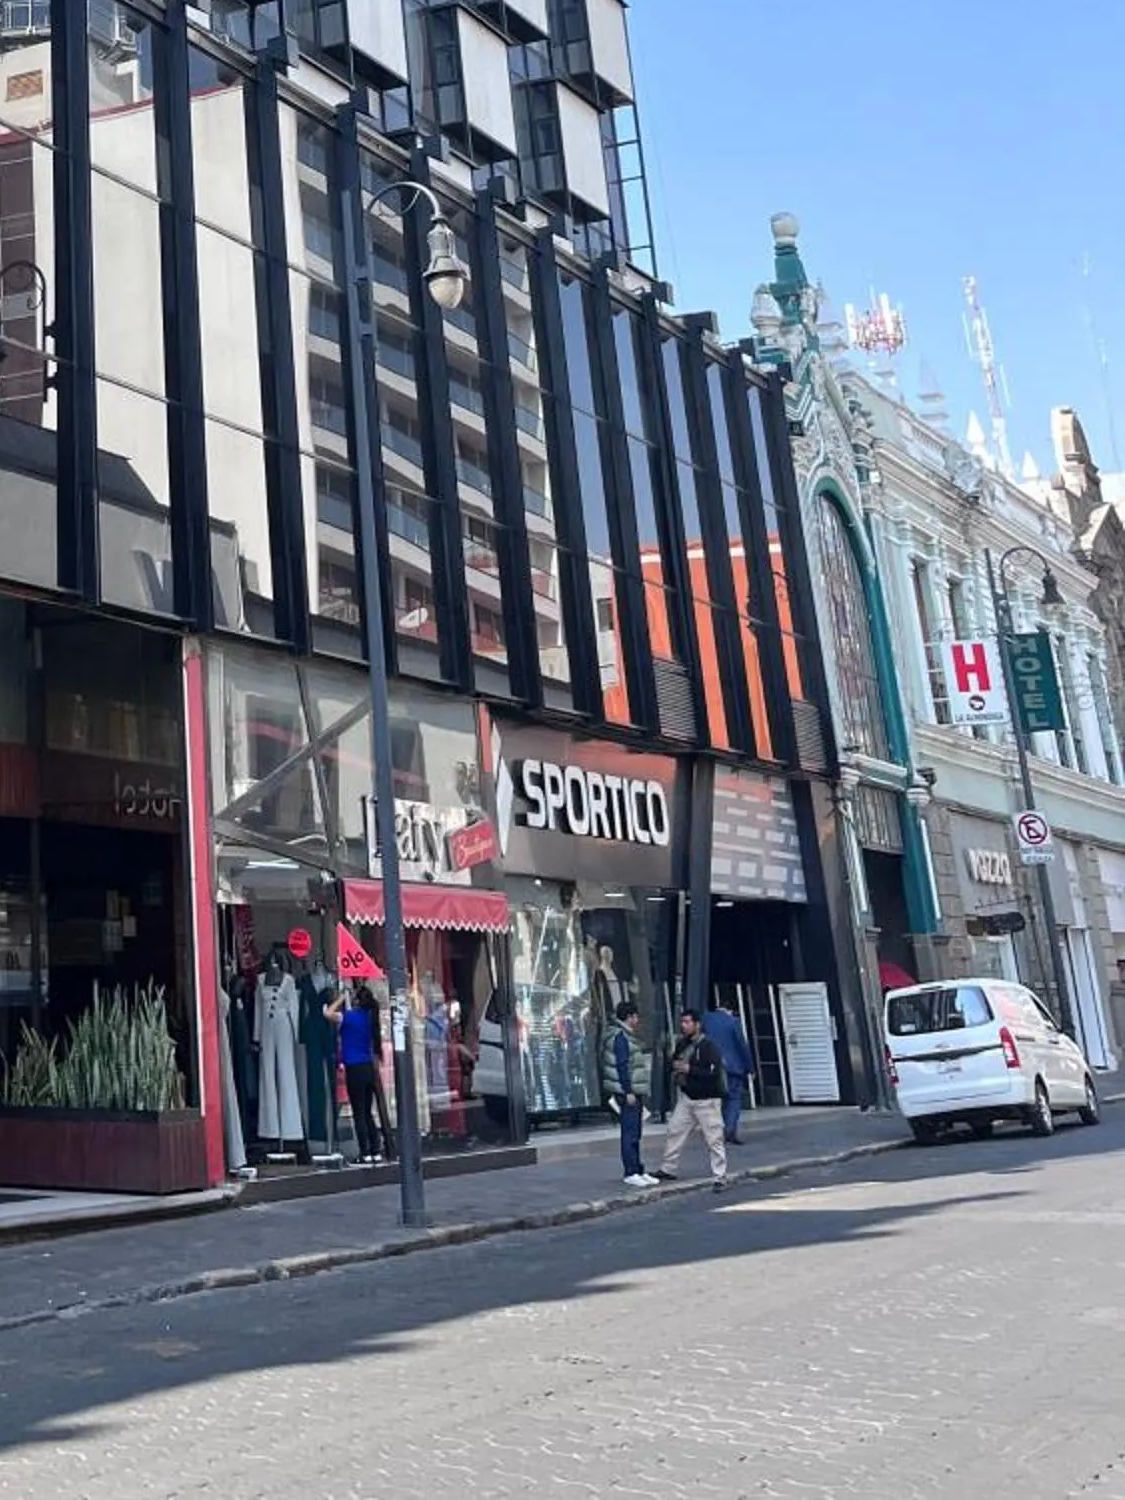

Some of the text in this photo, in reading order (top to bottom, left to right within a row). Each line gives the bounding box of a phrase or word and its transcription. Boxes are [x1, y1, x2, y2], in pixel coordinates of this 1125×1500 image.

[951, 643, 991, 693] H
[1012, 638, 1051, 727] HOTEL
[522, 758, 670, 847] SPORTICO
